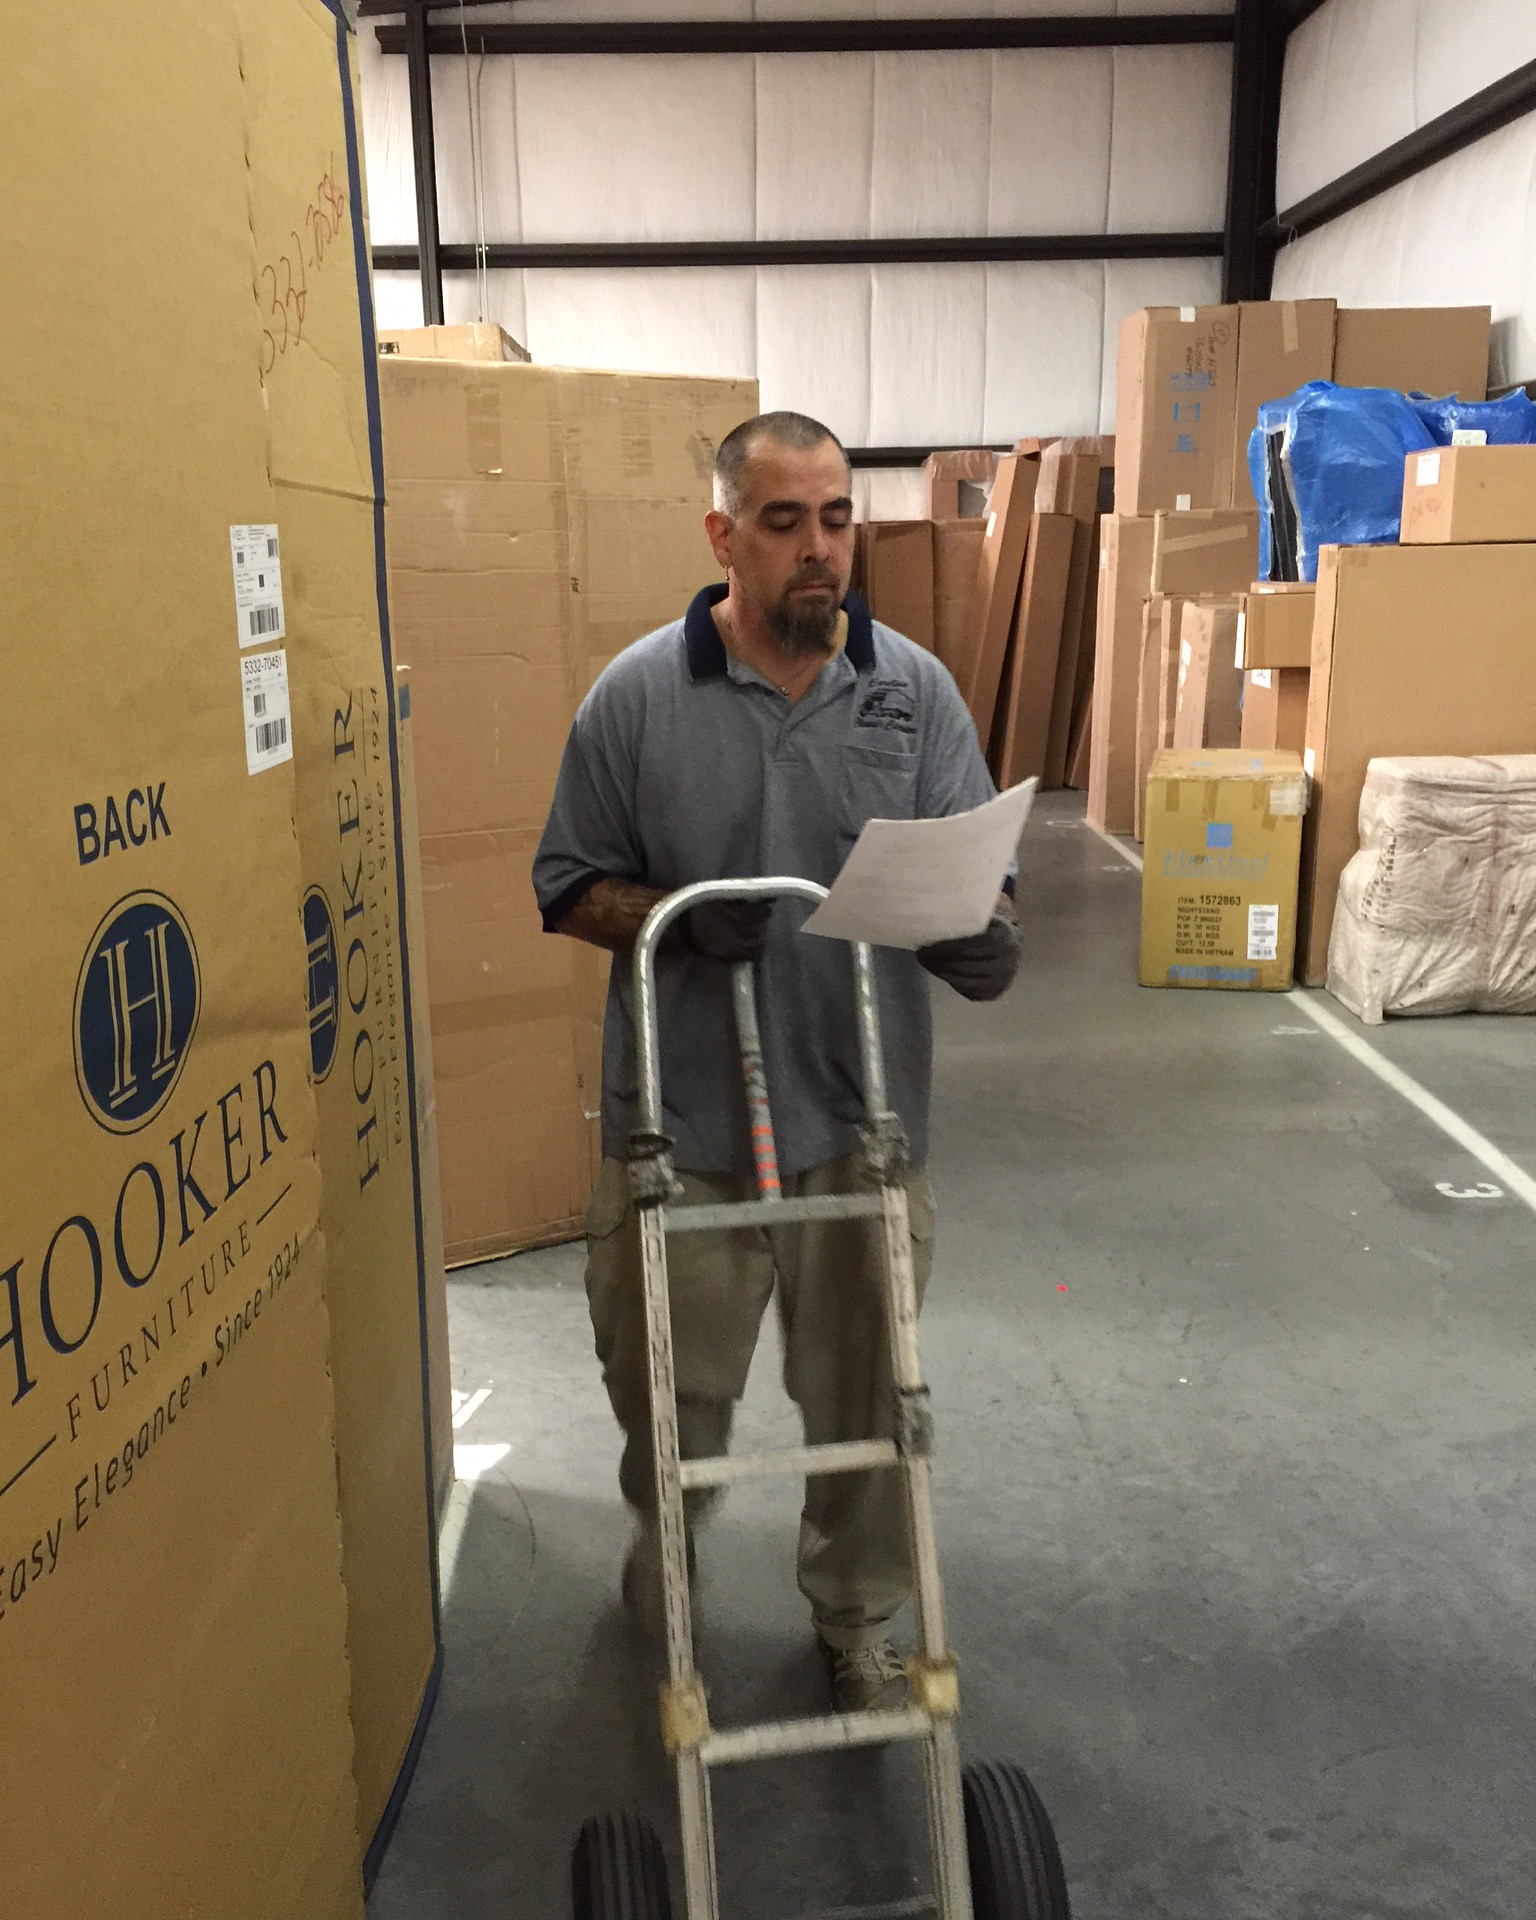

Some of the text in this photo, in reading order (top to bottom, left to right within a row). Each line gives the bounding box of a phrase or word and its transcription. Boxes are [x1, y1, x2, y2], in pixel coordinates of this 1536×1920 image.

[244, 655, 282, 675] 5332-70451
[369, 686, 381, 765] 1924
[74, 782, 172, 866] BACK
[363, 792, 387, 1070] FURNITURE
[1200, 895, 1241, 906] 1572863
[333, 689, 380, 1197] HOOKER
[1204, 949, 1234, 957] VIETNAM
[66, 1220, 252, 1443] FURNITURE
[74, 1375, 191, 1532] Elegance
[214, 1287, 263, 1368] Since
[267, 1232, 301, 1299] 1924
